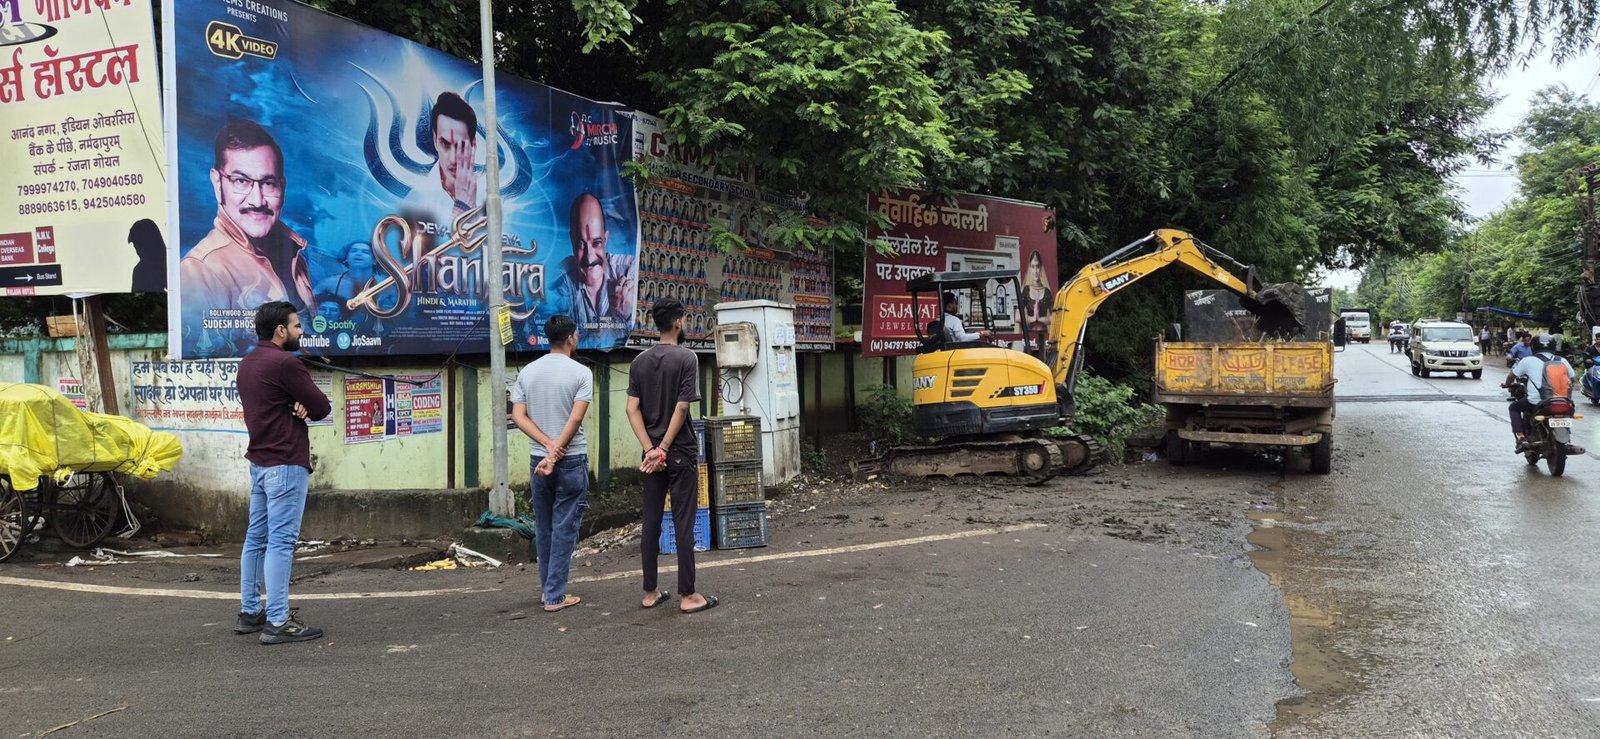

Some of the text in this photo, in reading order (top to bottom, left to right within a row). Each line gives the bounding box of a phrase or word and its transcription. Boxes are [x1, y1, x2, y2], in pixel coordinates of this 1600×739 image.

[227, 7, 257, 23] PRESENTS
[245, 0, 288, 22] CREATIONS
[210, 29, 274, 55] 4K VIDEO
[30, 44, 140, 99] हॉस्टल
[11, 109, 136, 140] आनंद नगर, इंडियन ओवरसिस
[587, 123, 618, 136] MIRCHI
[28, 141, 44, 157] बैंक
[46, 139, 54, 155] के
[57, 137, 77, 154] पीछे,
[33, 159, 56, 176] संपर्क
[67, 157, 91, 172] रंजना
[94, 153, 120, 169] गोयल
[18, 174, 144, 196] 7999974270, 7049040580
[681, 173, 730, 192] SECONDARY
[19, 194, 146, 215] 8889063615, 9425040580
[924, 235, 939, 256] रेट
[876, 263, 893, 280] पर
[1105, 272, 1129, 290] SANY
[417, 297, 477, 307] HINDI & MARATHI
[209, 309, 241, 317] BOLLYWOOD
[203, 319, 232, 329] SUDESH
[328, 320, 356, 330] Spotify
[299, 335, 330, 348] YouTube
[351, 334, 382, 347] JioSaavn
[870, 339, 883, 352] (M)
[884, 341, 904, 350] 94797
[132, 361, 150, 378] हम
[913, 375, 936, 389] ANY
[178, 385, 208, 401] अपना
[413, 395, 440, 409] CODING
